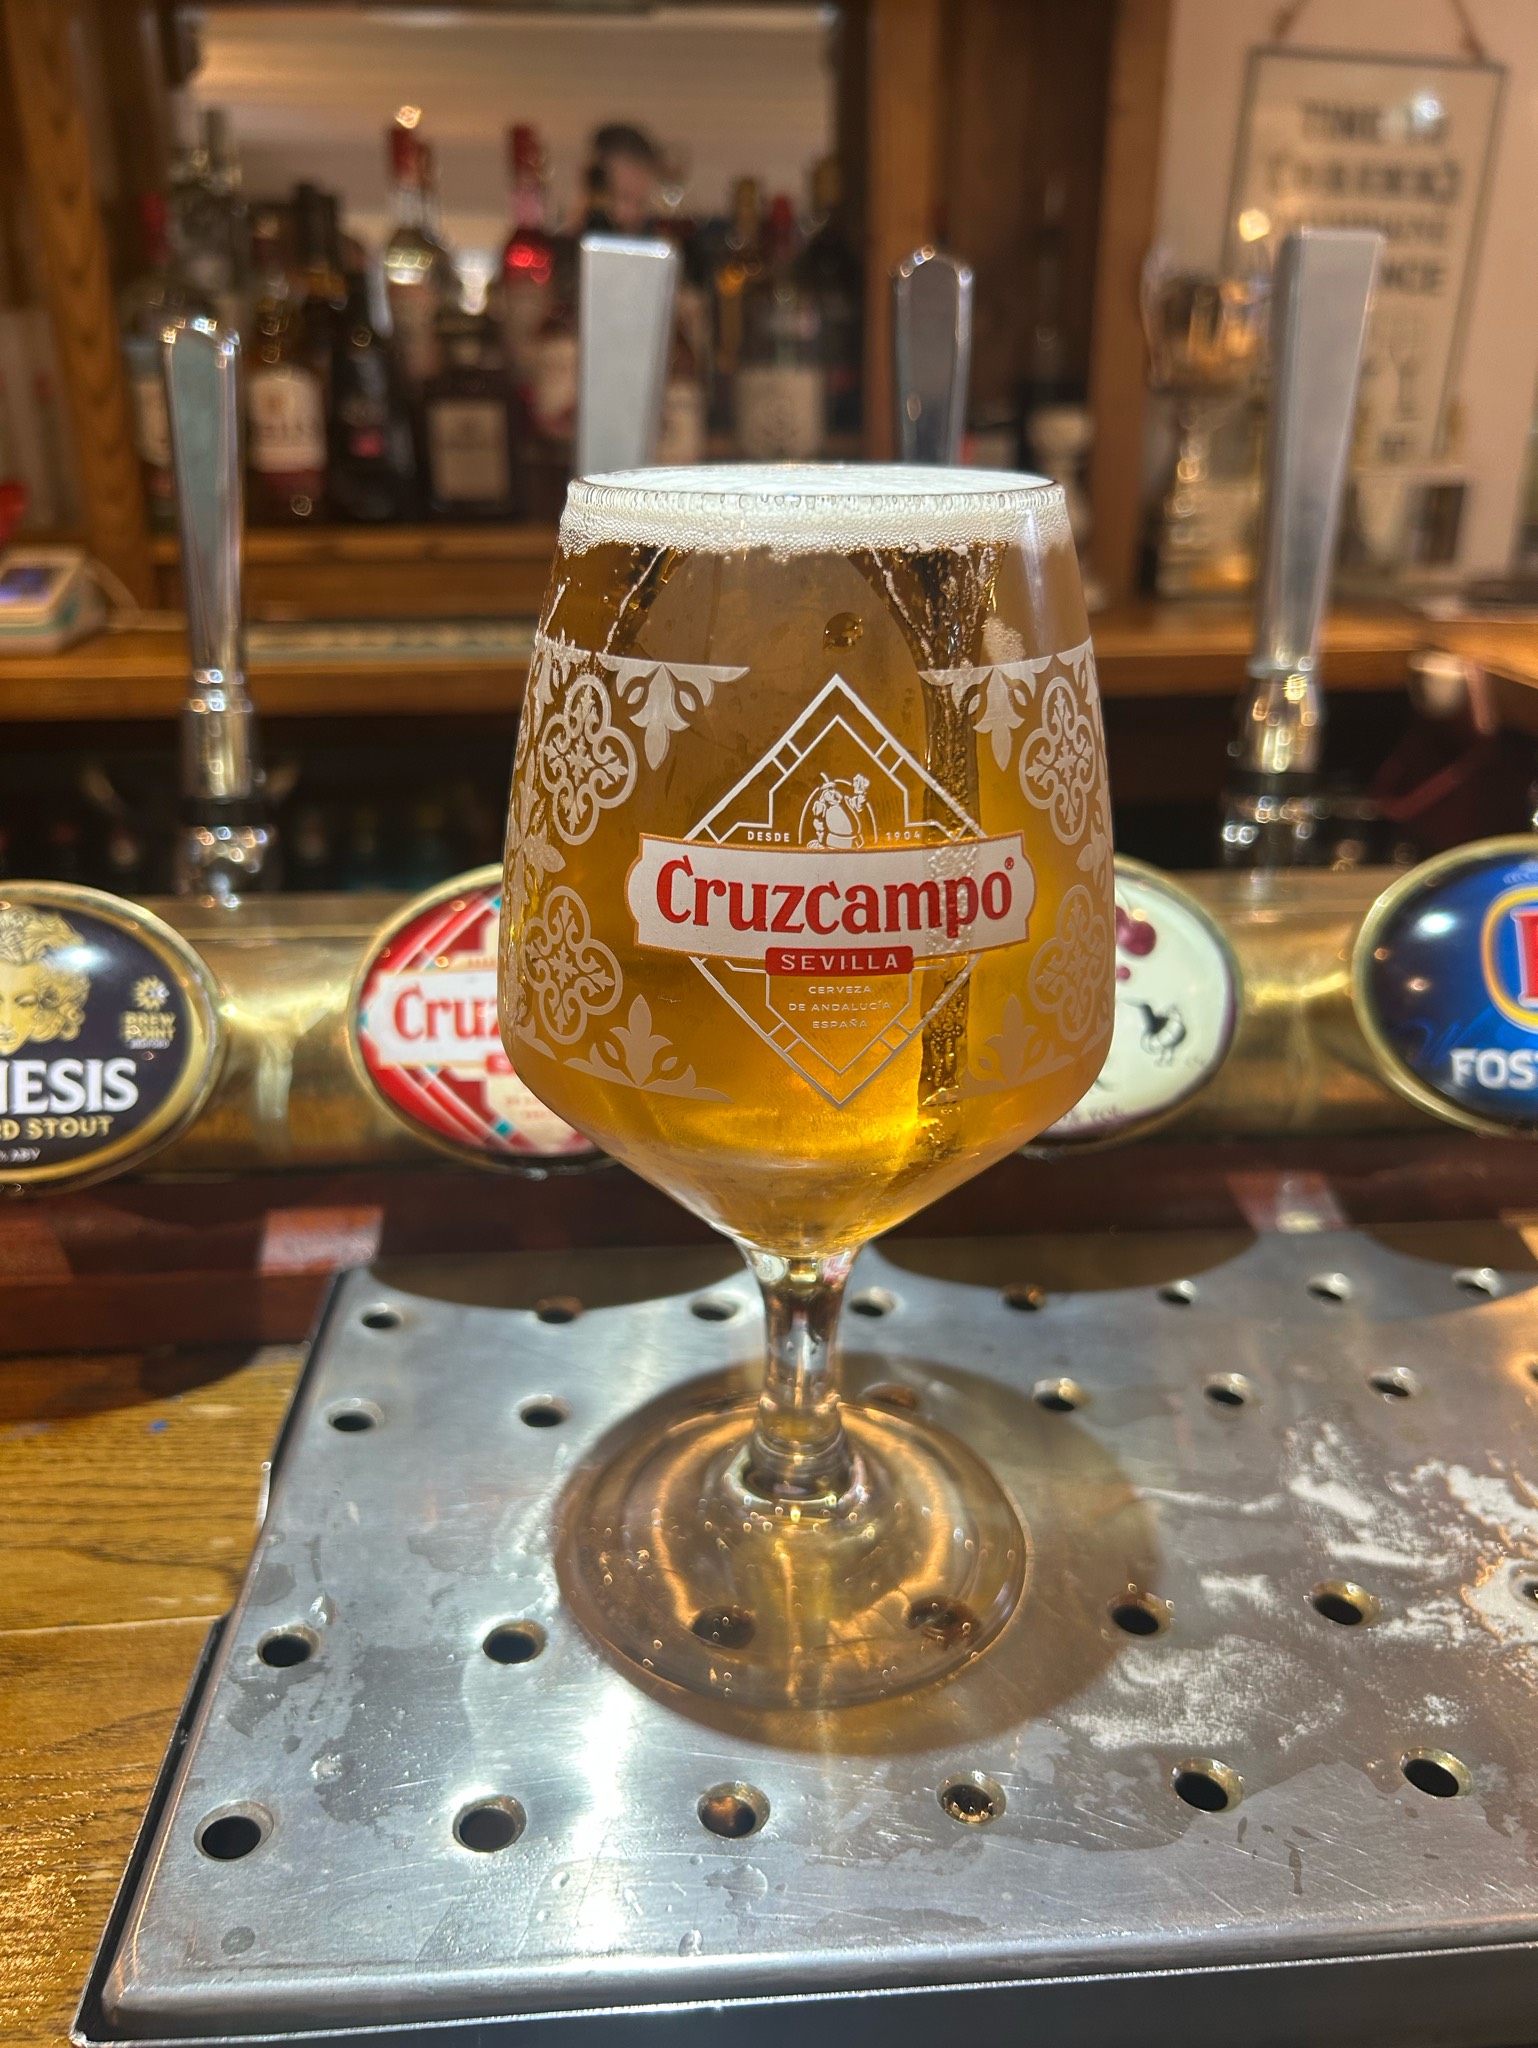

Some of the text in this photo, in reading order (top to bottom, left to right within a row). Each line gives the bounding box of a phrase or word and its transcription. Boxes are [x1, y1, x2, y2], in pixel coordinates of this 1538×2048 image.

[747, 831, 921, 843] DESDE 1904
[781, 954, 899, 971] SEVILLA
[808, 985, 872, 995] CERVEZA
[788, 1003, 806, 1012] DE
[812, 1018, 868, 1029] ESPAÑA
[1451, 1048, 1538, 1090] FOS
[25, 1115, 114, 1140] STOUT
